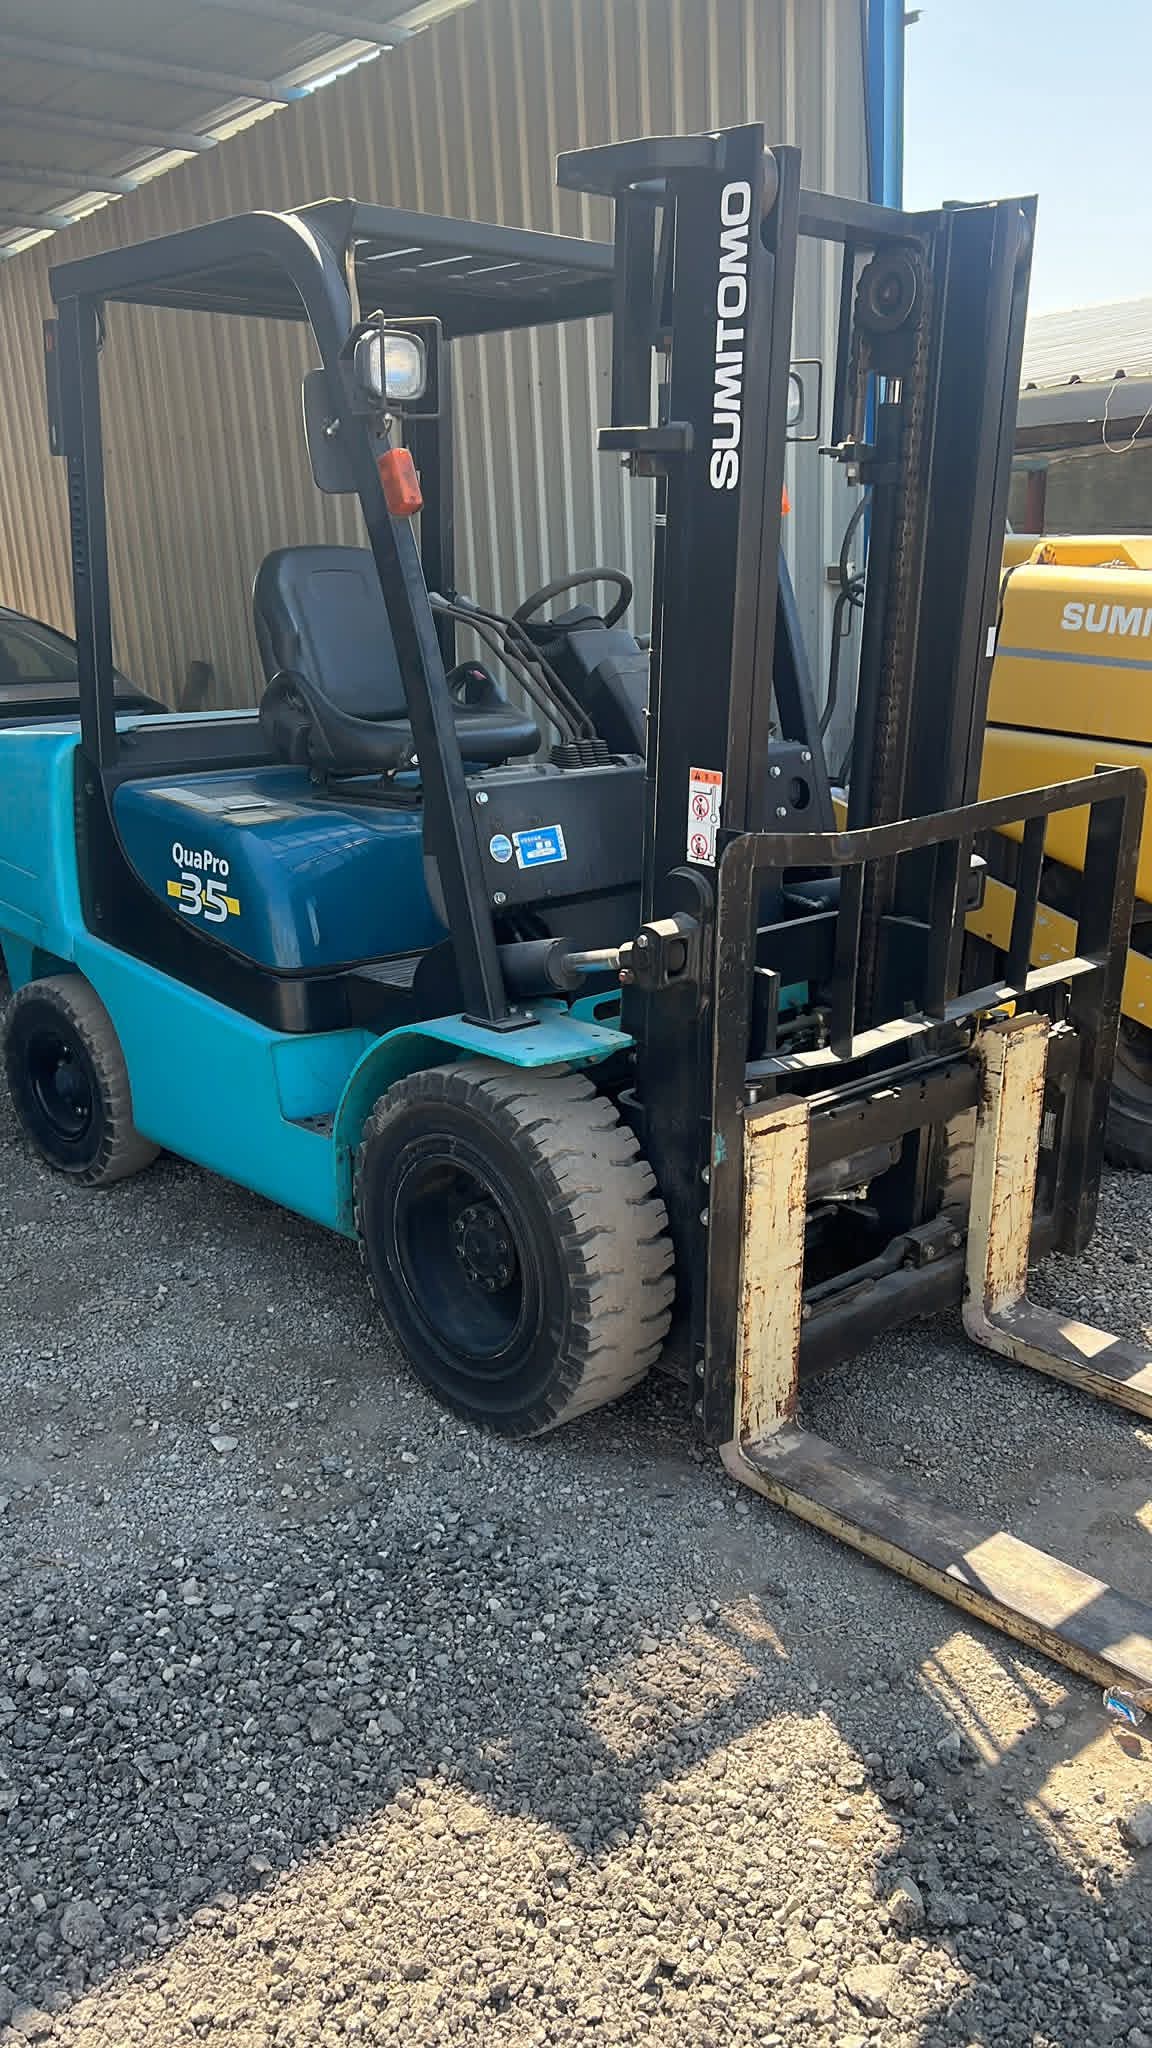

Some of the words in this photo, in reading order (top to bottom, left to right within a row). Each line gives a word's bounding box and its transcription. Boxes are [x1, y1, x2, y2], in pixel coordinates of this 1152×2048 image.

[710, 181, 751, 490] SUMITOMO
[1061, 602, 1152, 637] SUMI
[172, 842, 229, 876] QuaPro
[178, 872, 228, 923] 35
